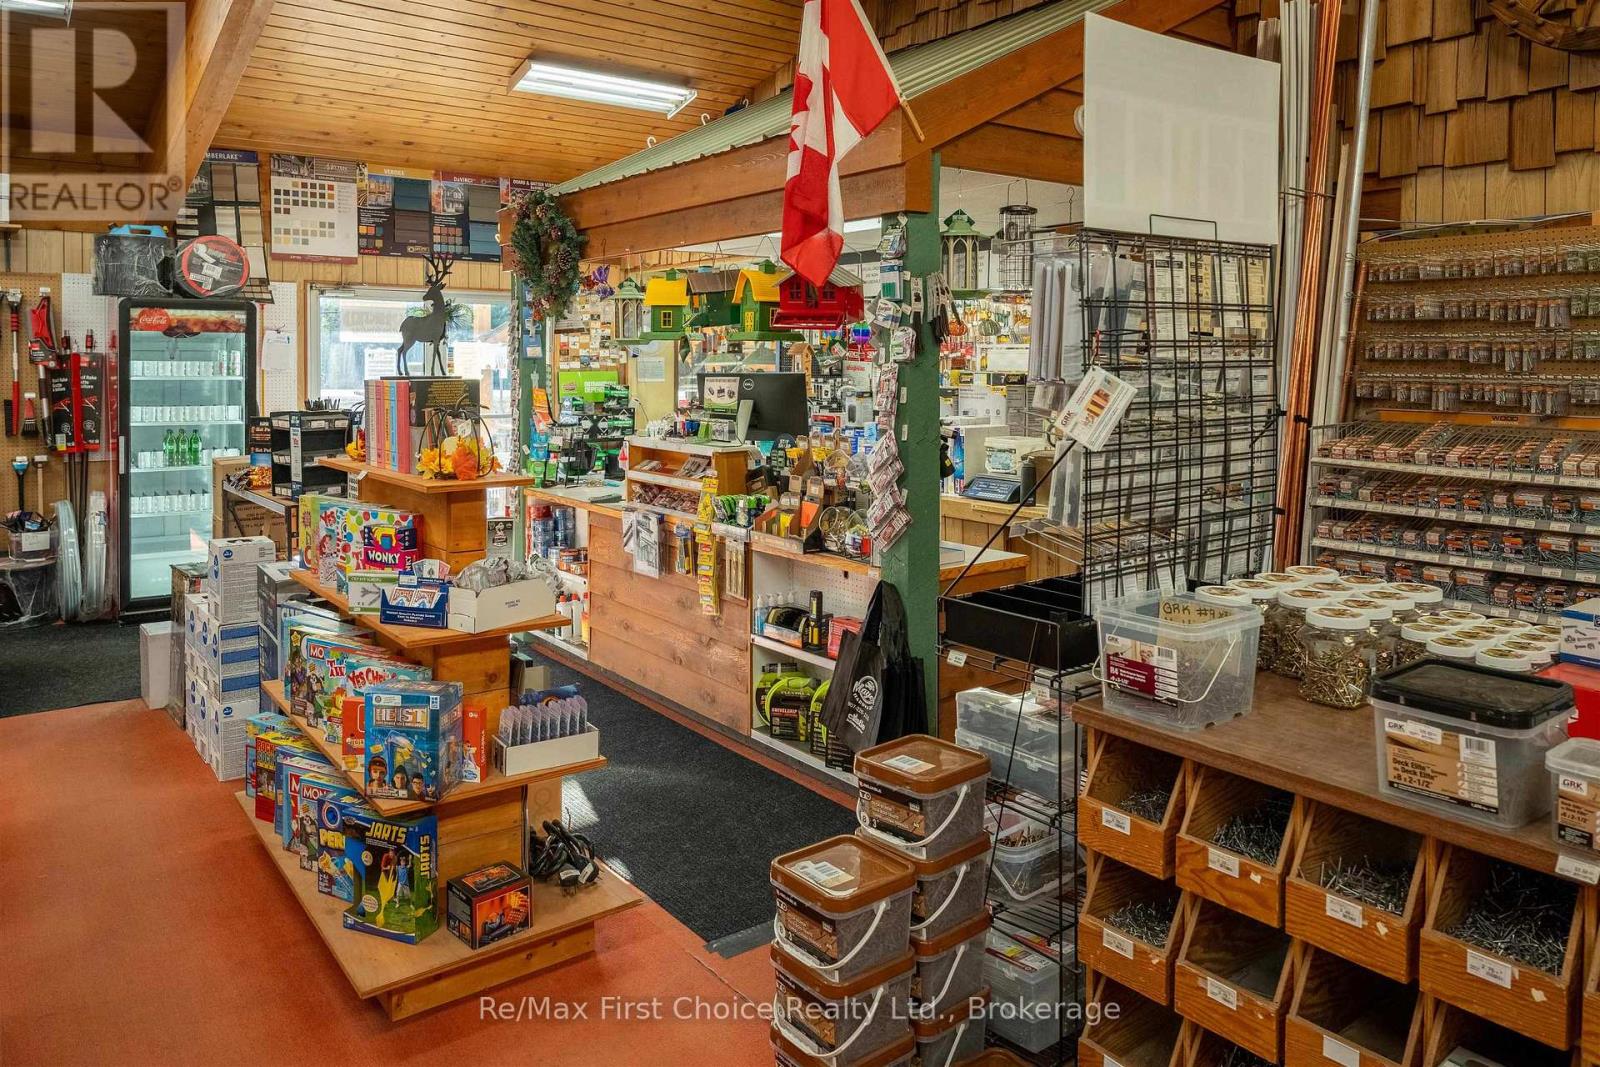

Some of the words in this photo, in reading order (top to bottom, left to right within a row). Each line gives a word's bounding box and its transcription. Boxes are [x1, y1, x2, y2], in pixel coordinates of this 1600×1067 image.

[1060, 410, 1074, 426] GRK
[368, 551, 400, 564] WONKY
[375, 706, 426, 724] HEIST
[1388, 721, 1405, 731] GRK
[1392, 757, 1409, 767] Deck
[1401, 766, 1418, 777] Deck
[1562, 778, 1584, 789] GRK
[366, 822, 407, 844] JARTS
[420, 835, 431, 878] JARTS
